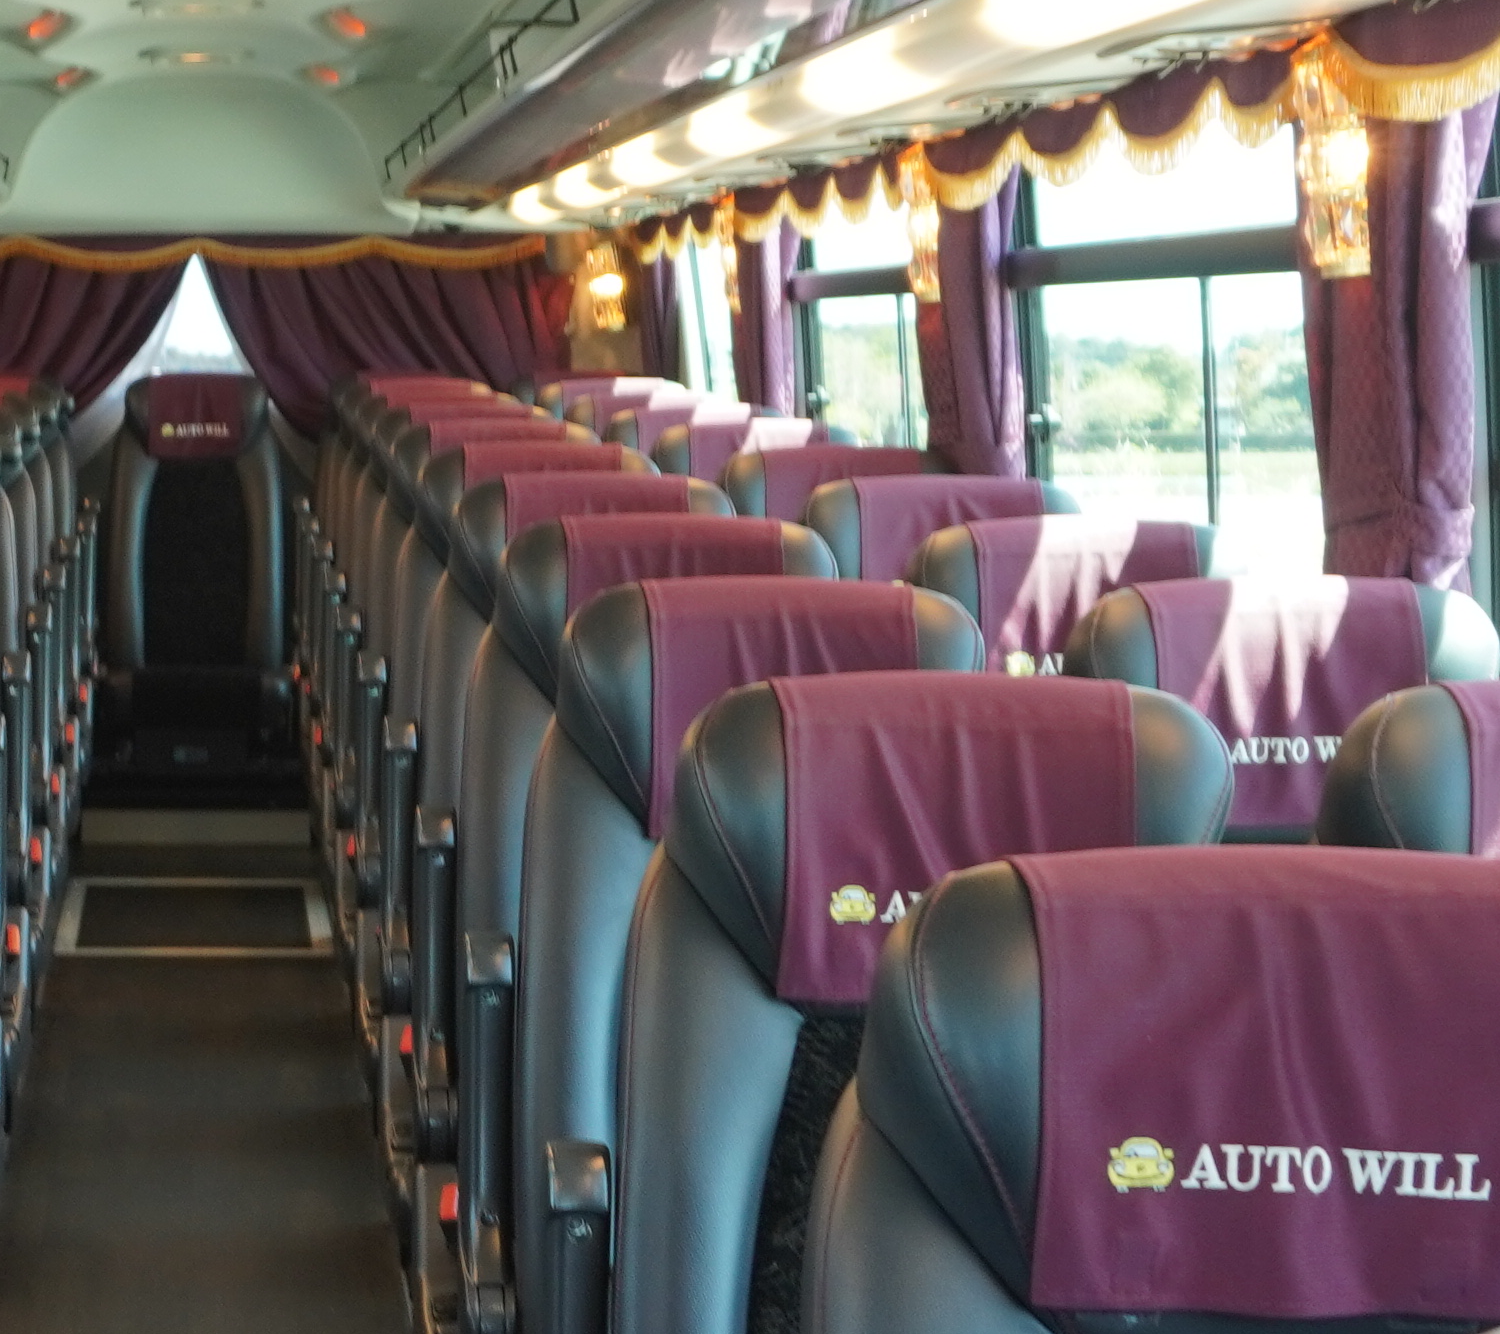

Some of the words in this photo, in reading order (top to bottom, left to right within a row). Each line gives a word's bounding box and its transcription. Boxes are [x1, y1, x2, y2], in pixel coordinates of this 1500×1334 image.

[1231, 736, 1310, 764] AUTO
[1180, 1143, 1333, 1195] AUTO
[1342, 1147, 1492, 1201] WILL
